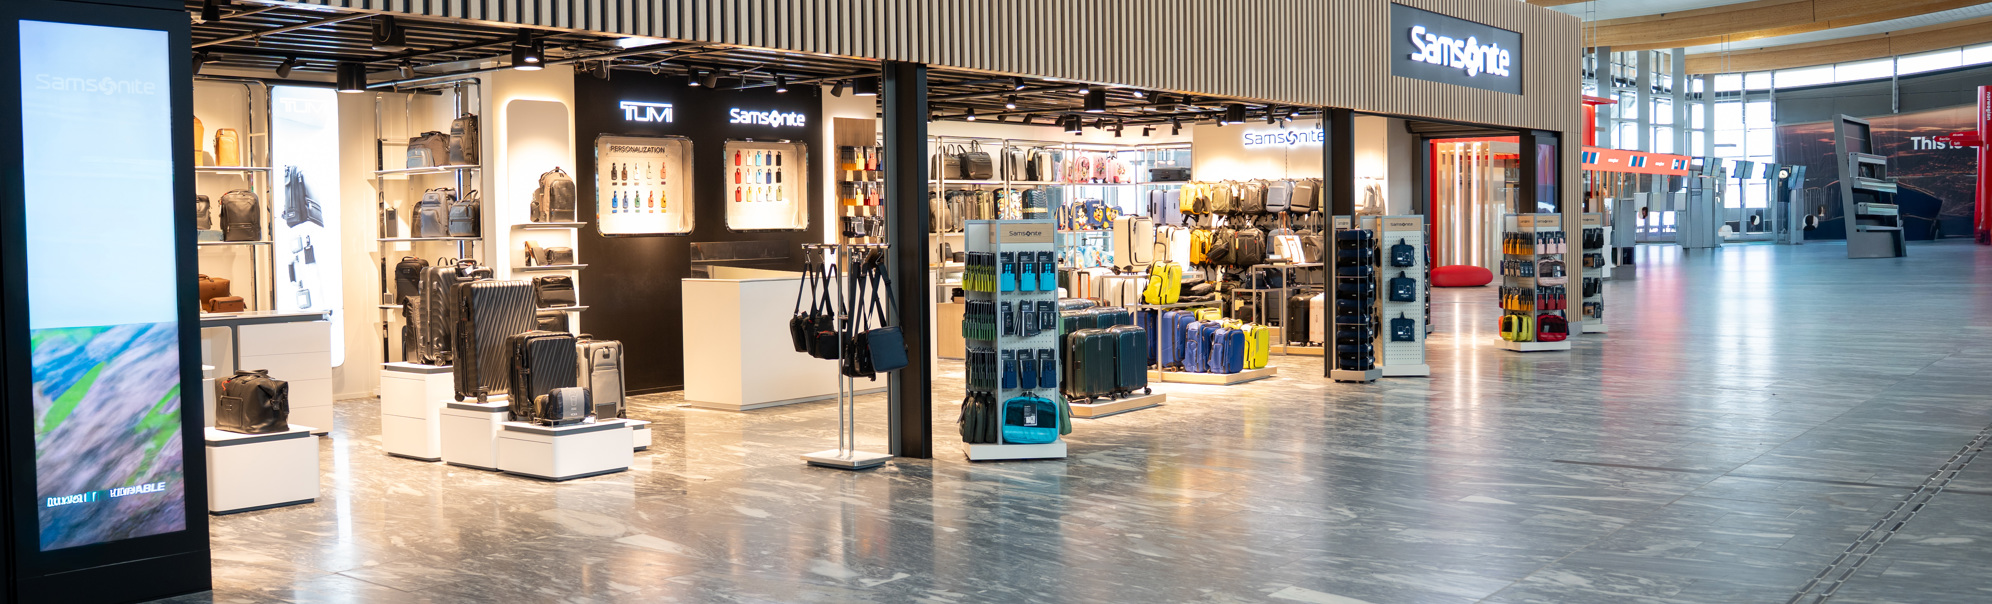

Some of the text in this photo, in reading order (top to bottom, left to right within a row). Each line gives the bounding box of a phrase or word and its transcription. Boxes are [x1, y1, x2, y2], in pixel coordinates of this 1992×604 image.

[1411, 25, 1510, 77] Samsonite
[35, 73, 156, 96] Samsonite
[619, 101, 673, 123] TUMI
[729, 108, 806, 127] Samsonite
[1244, 130, 1324, 146] Samsonite
[1910, 135, 1946, 150] This
[610, 145, 666, 154] PERSONALIZATION
